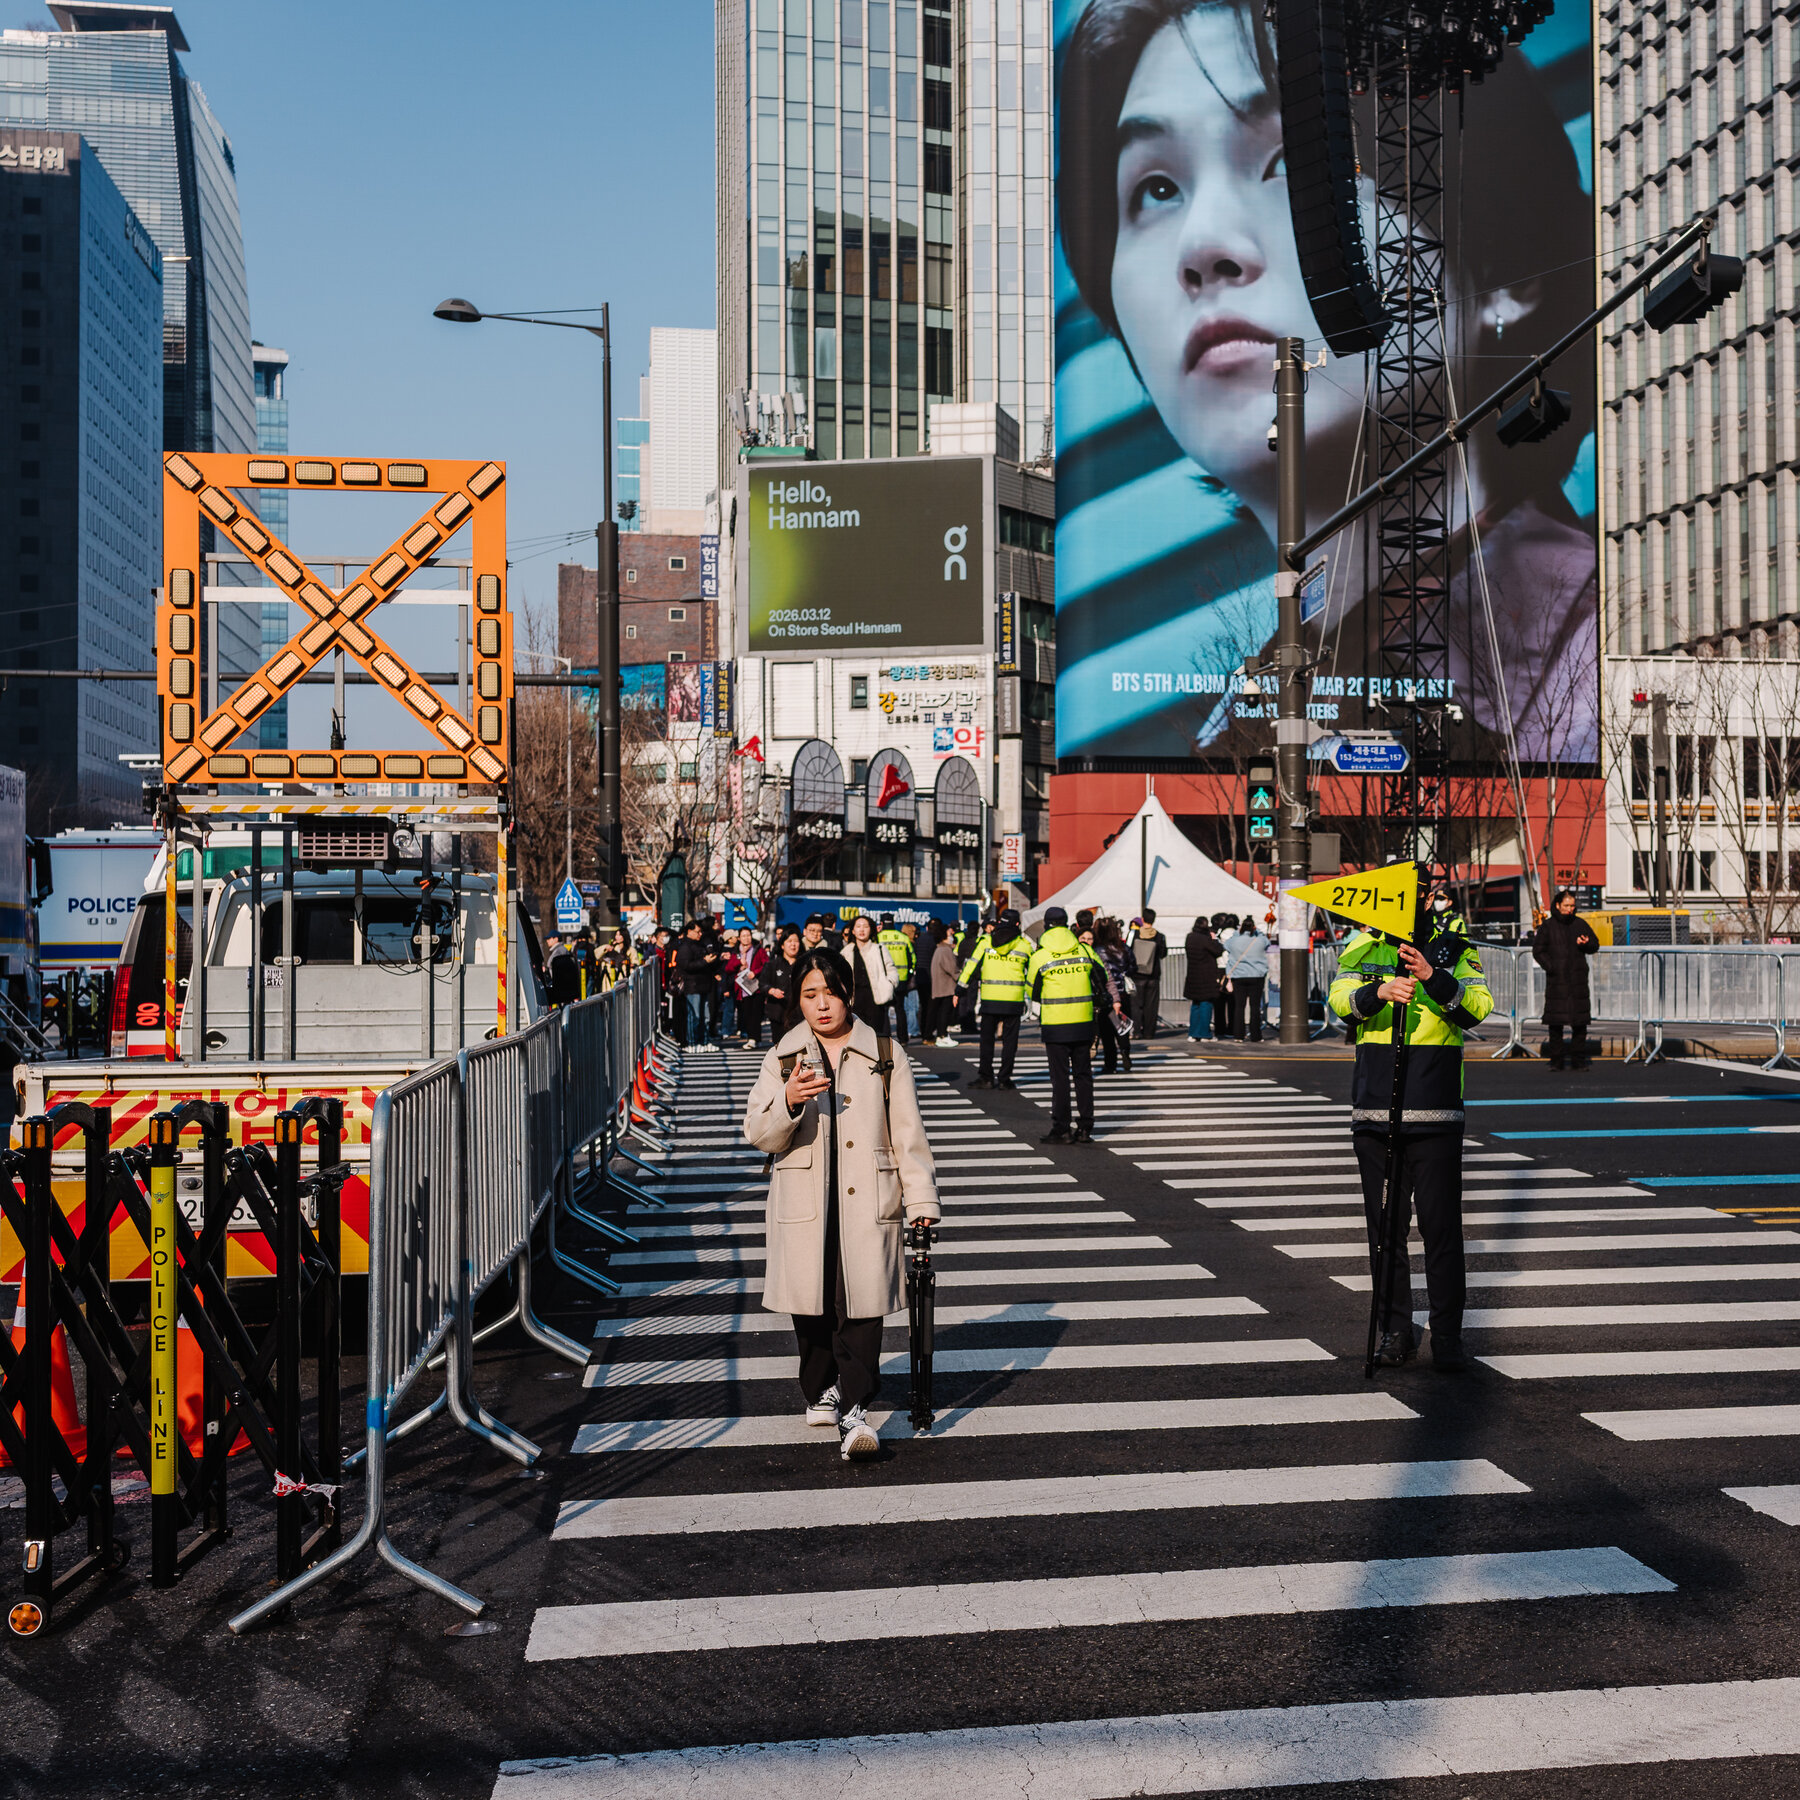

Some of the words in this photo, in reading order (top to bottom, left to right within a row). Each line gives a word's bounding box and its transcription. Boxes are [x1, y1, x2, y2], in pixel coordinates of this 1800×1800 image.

[768, 480, 832, 507] Hello,
[768, 507, 860, 530] Hannam
[702, 546, 718, 595] 한의원
[768, 608, 832, 622] 2026.03.12
[768, 624, 786, 637] On
[787, 624, 819, 637] Store
[820, 622, 853, 636] Seoul
[855, 622, 902, 634] Hannam
[1112, 672, 1140, 692] BTS
[1143, 672, 1172, 693] 5TH
[1176, 673, 1226, 694] ALBUM
[1312, 676, 1345, 696] MAR
[878, 690, 982, 714] 강비뇨기과
[954, 726, 985, 758] 약
[1353, 746, 1387, 756] 세종대로
[1249, 816, 1273, 838] 25
[1005, 838, 1019, 874] 약국
[68, 897, 137, 913] POLICE
[1331, 886, 1406, 911] 27기-1
[988, 955, 1021, 963] POLICE
[1050, 965, 1089, 976] POLICE
[152, 1227, 168, 1352] POLICE
[154, 1377, 168, 1460] LINE
